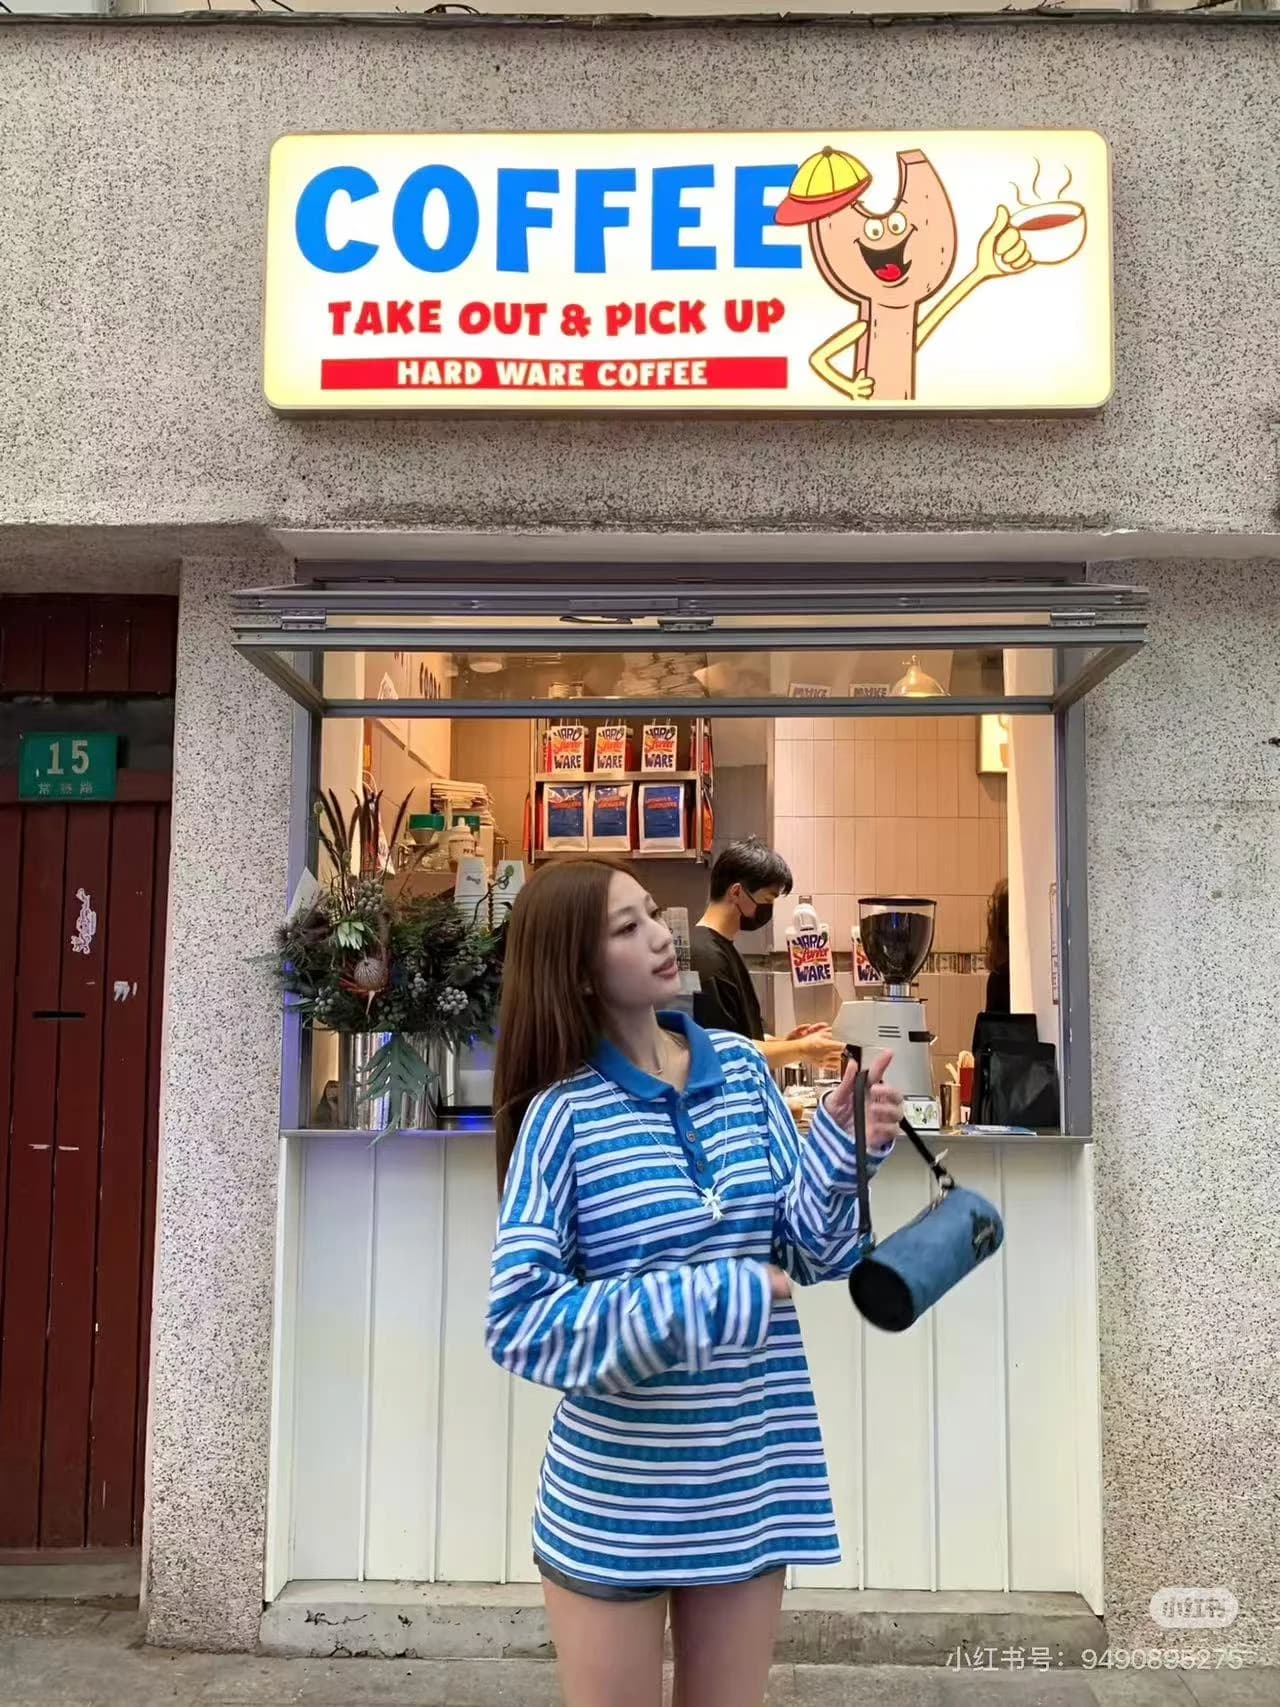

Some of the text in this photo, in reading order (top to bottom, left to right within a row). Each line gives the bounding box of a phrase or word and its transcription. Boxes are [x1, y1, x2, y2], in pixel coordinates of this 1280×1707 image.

[295, 164, 803, 273] COFFEE
[328, 298, 786, 338] TAKE OUT & PICK UP
[397, 360, 708, 387] HARD WARE COFFEE
[47, 740, 89, 774] 15
[795, 964, 831, 983] WARE
